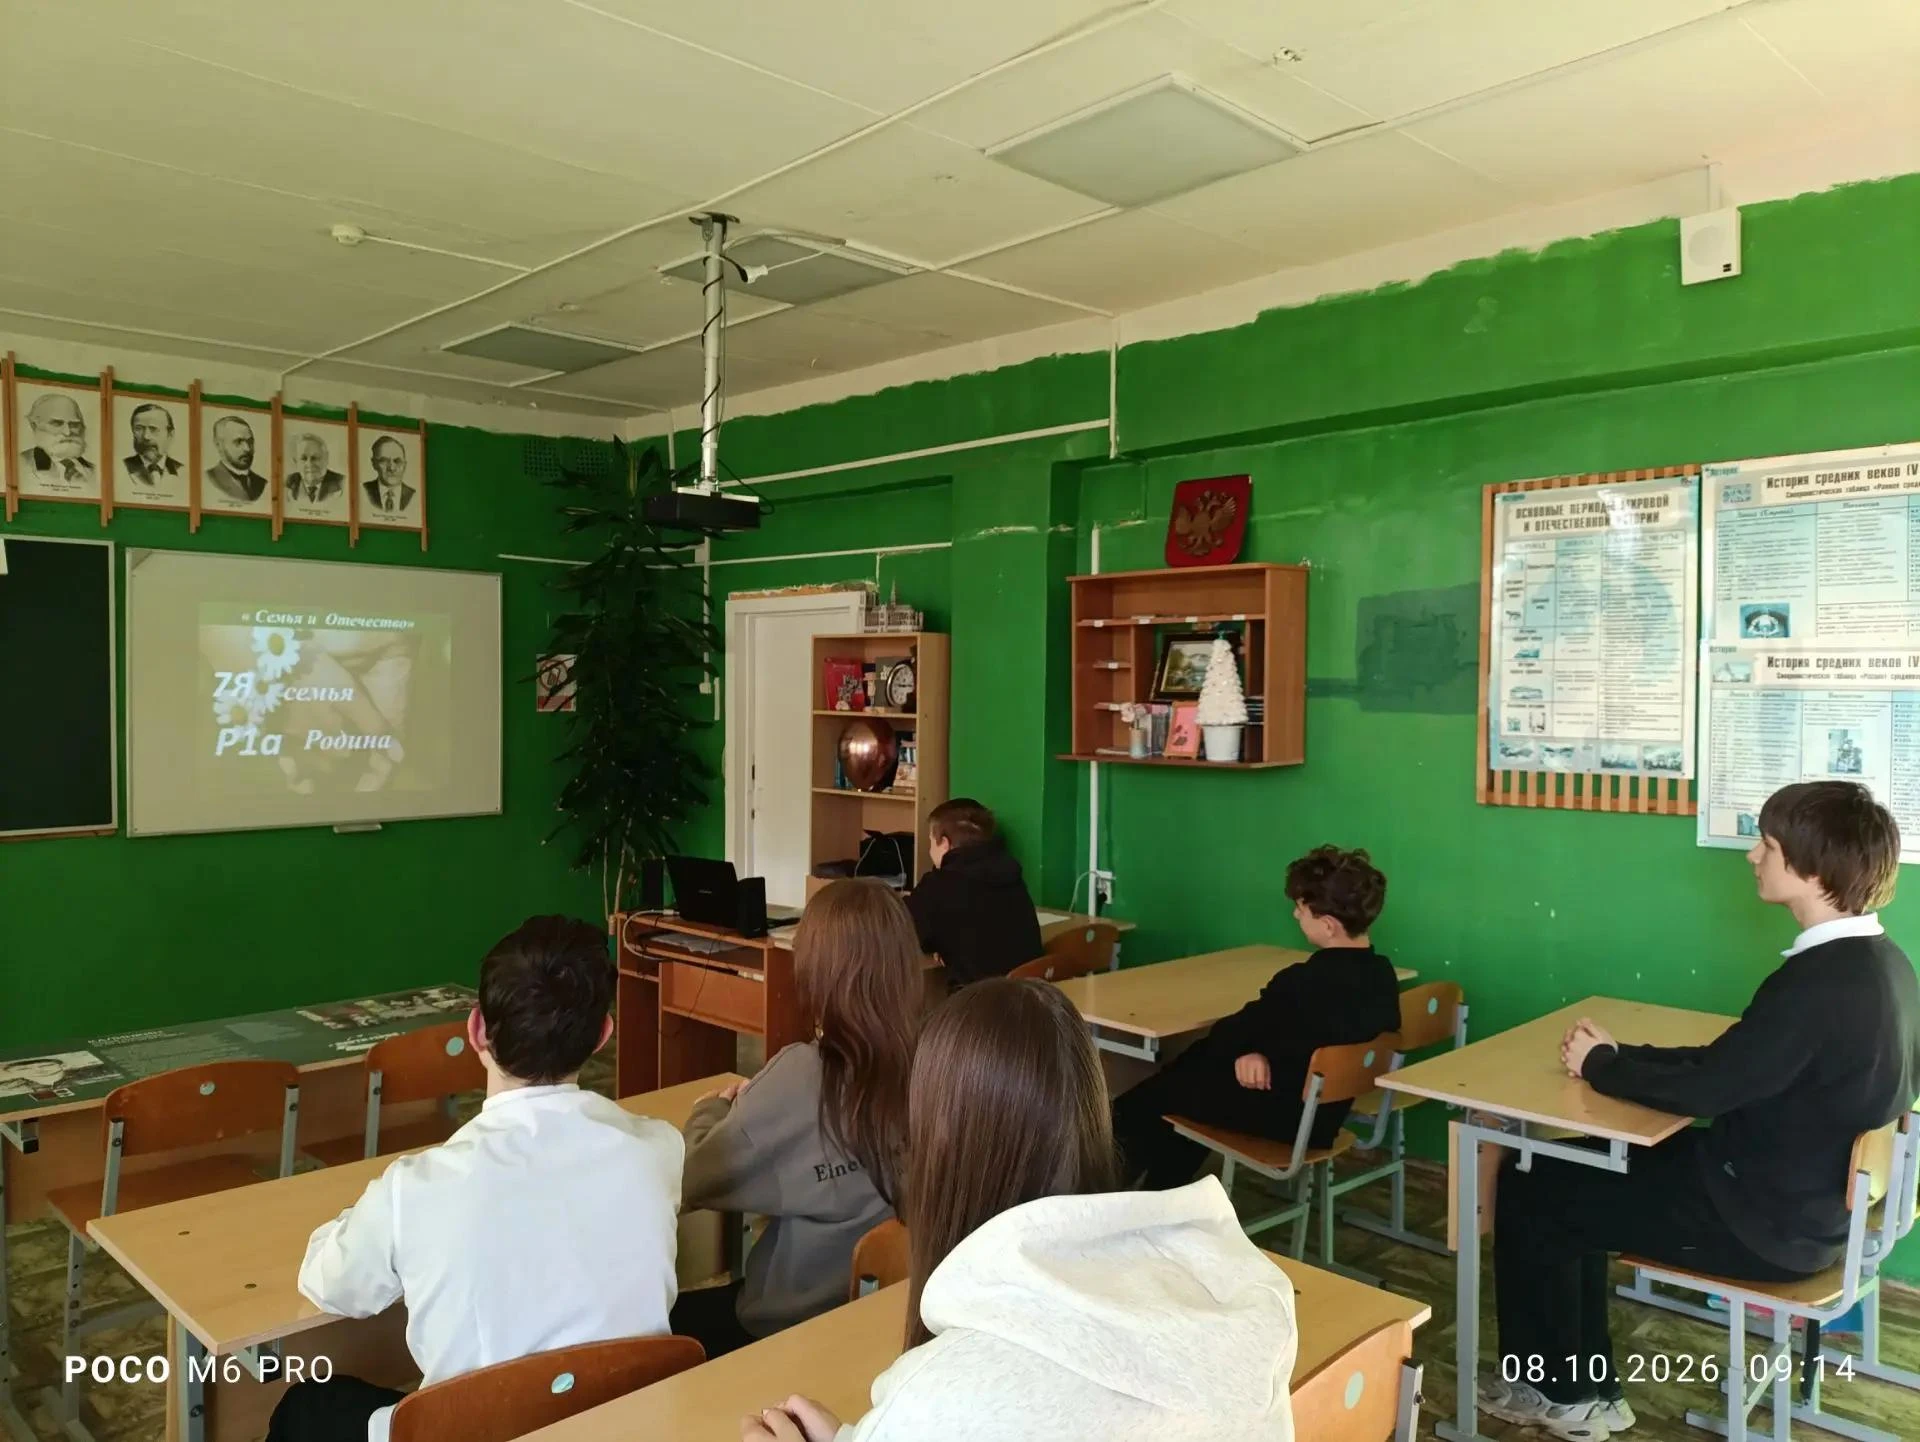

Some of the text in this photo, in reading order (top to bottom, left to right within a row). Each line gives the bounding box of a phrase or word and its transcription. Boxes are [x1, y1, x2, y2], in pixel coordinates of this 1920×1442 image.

[1766, 475, 1809, 489] История
[1815, 471, 1860, 486] средних
[1867, 467, 1900, 480] веков
[1516, 505, 1563, 519] ОСНОВНЫЕ
[1523, 511, 1660, 532] И ОТЕЧЕСТВЕННОЙ СТОРИИ
[308, 614, 317, 625] и
[1767, 656, 1810, 670] История
[1816, 658, 1861, 670] средних
[283, 686, 354, 701] семья
[303, 729, 393, 750] Родина
